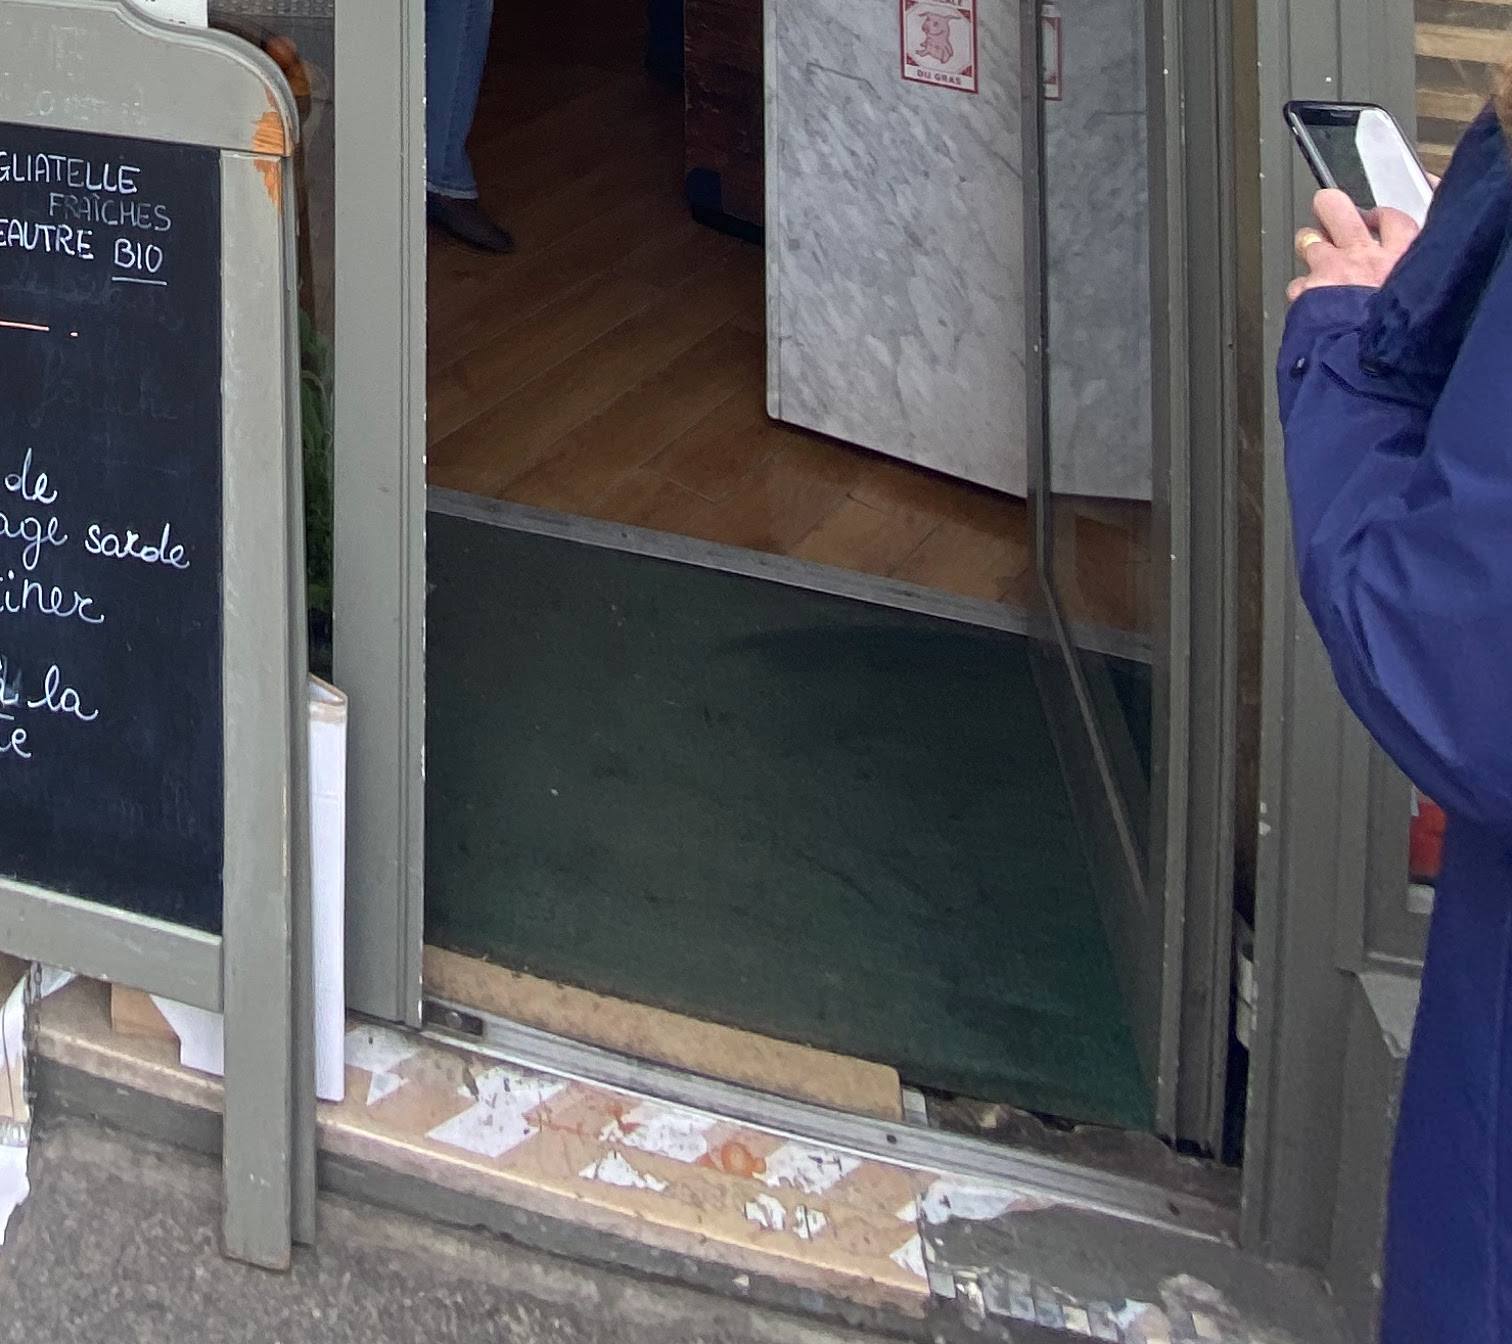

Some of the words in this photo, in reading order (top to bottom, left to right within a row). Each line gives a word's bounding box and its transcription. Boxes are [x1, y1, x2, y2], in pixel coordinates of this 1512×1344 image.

[917, 69, 931, 79] DU
[934, 73, 961, 85] GRAS
[113, 238, 164, 273] BIO
[5, 447, 58, 504] de
[84, 523, 190, 569] sarde
[27, 664, 99, 721] la
